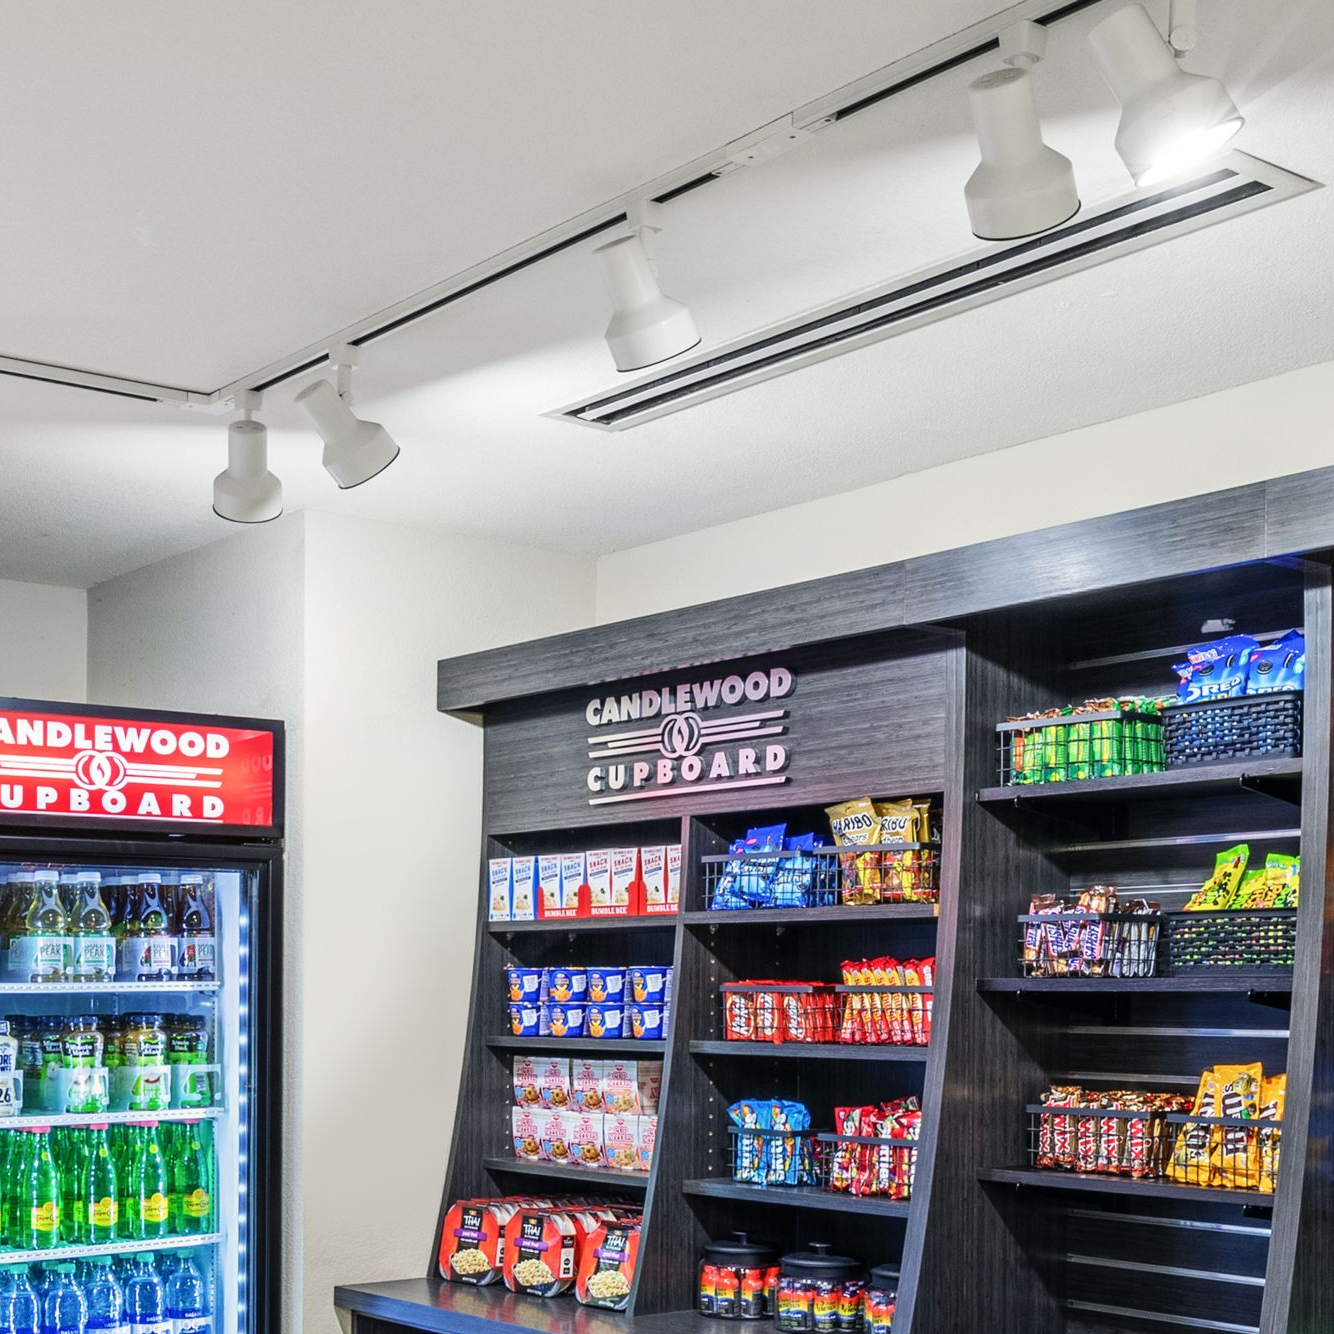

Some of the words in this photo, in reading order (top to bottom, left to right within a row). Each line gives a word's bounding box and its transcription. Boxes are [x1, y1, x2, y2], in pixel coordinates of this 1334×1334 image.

[585, 667, 794, 727] CANDLEWOOD
[1187, 677, 1241, 699] OREO
[587, 744, 790, 792] CUPBOARD
[832, 814, 873, 835] HARIBO
[523, 1224, 541, 1236] THAI
[607, 1235, 625, 1247] THAI
